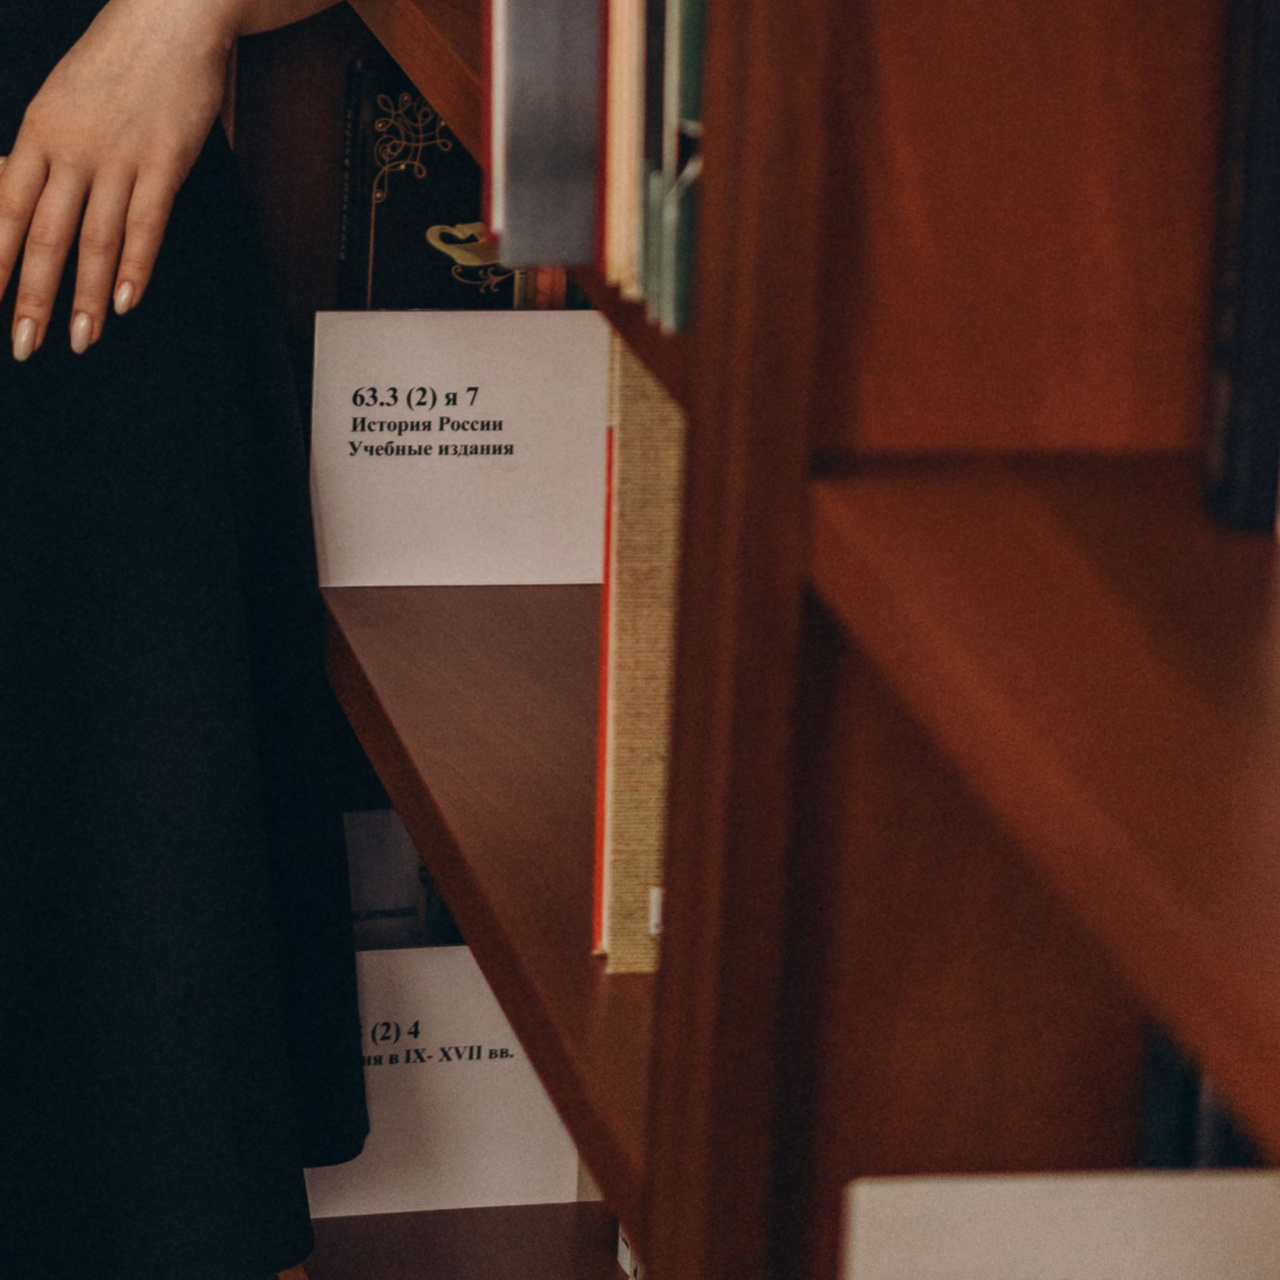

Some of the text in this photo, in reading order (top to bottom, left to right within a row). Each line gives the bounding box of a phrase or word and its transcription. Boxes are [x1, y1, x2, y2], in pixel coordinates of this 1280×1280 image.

[351, 386, 479, 411] 63.3 (2) я 7
[351, 416, 504, 436] История России
[348, 440, 515, 457] Учебные издания
[371, 1019, 420, 1045] (2) 4
[388, 1054, 400, 1066] в
[405, 1047, 434, 1064] IX-
[439, 1044, 483, 1062] XVII
[488, 1047, 515, 1060] вв.
